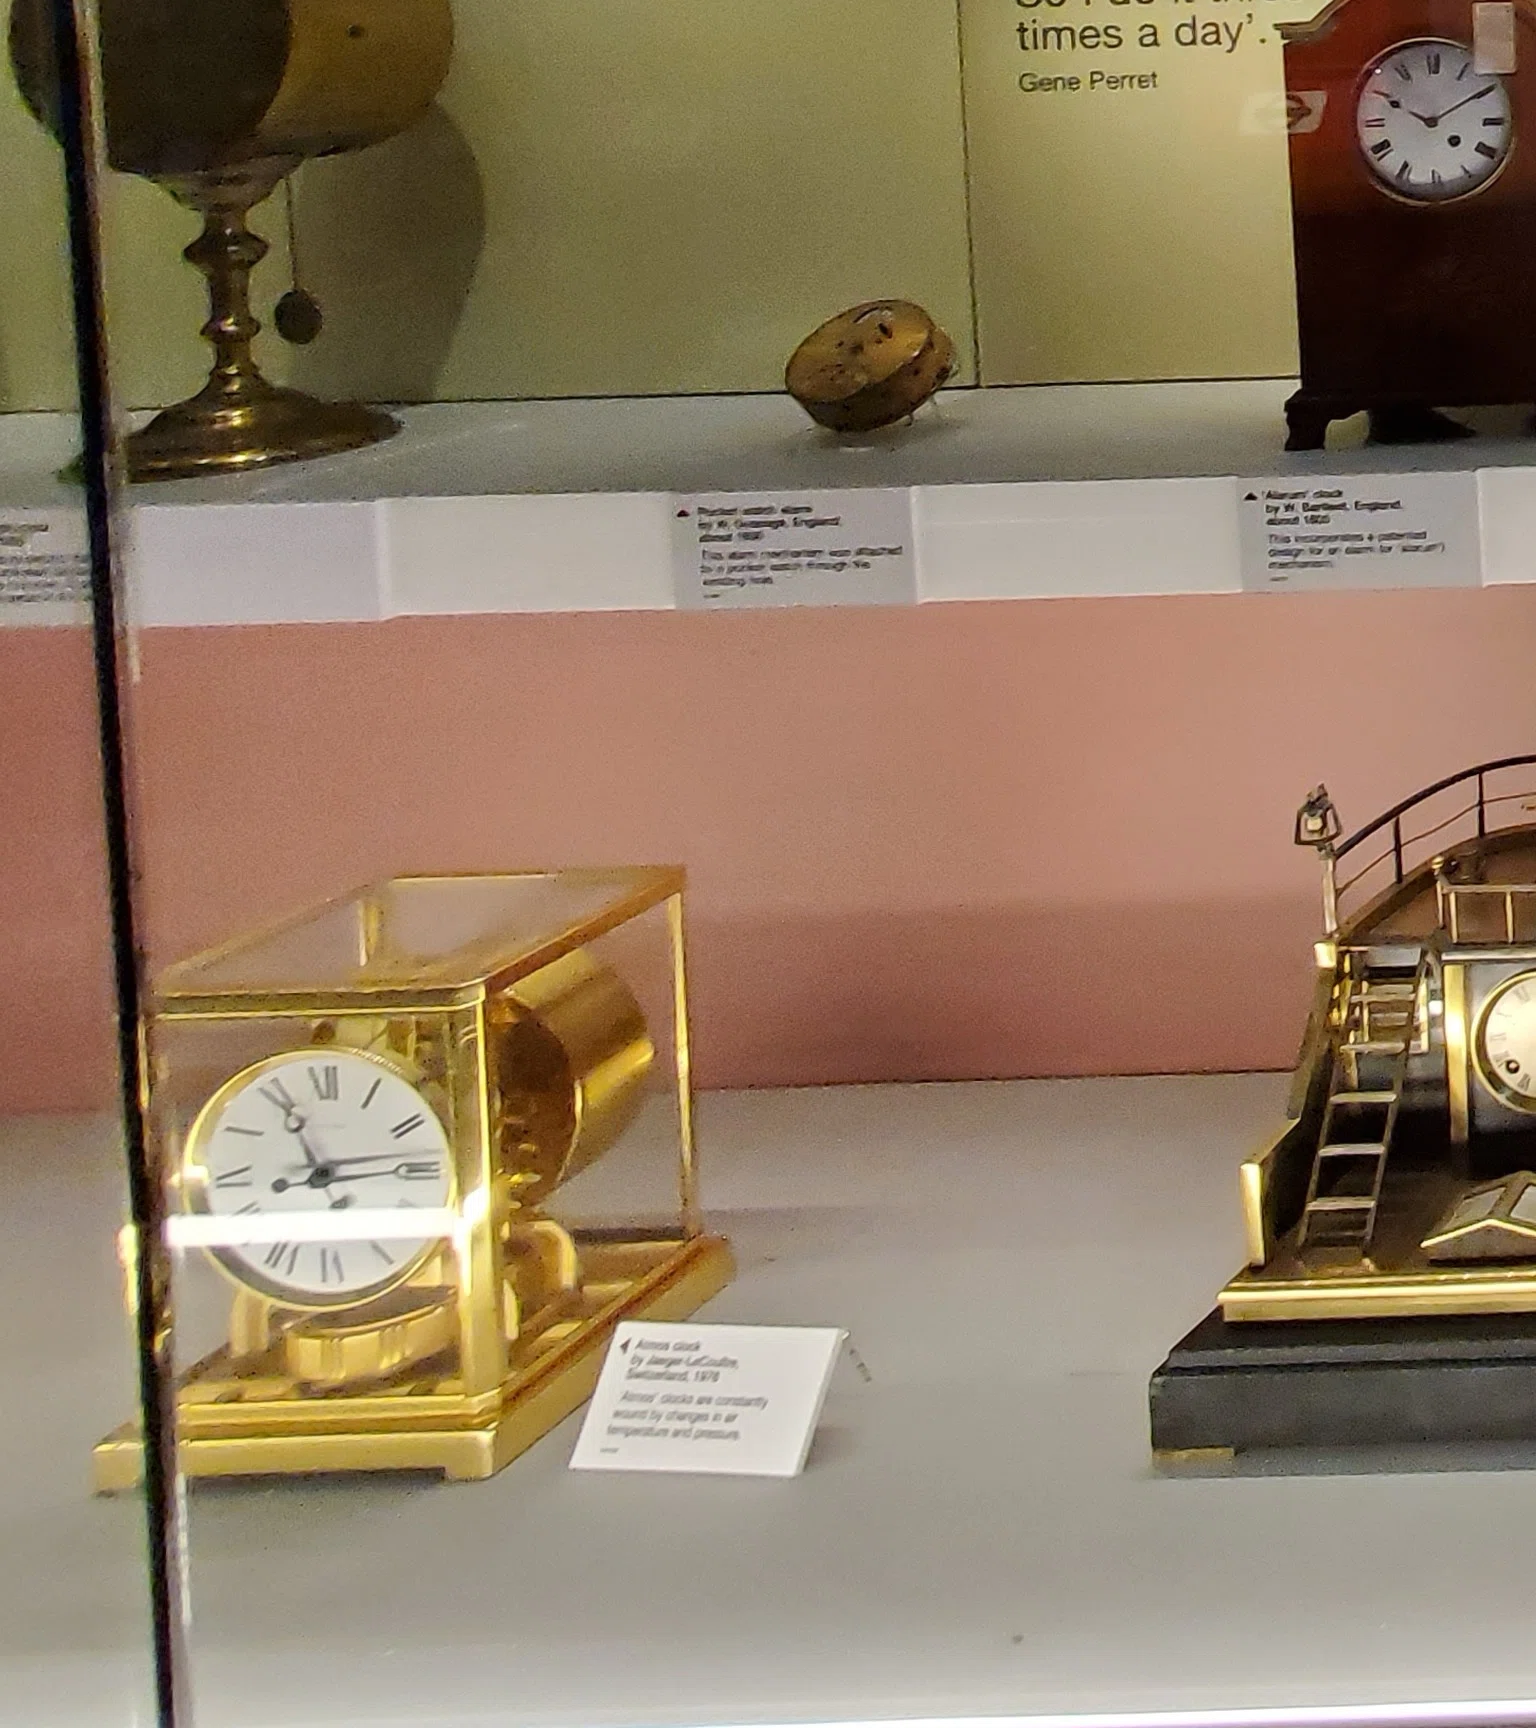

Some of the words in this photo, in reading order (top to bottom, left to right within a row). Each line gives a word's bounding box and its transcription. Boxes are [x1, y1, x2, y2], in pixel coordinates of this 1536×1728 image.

[1016, 19, 1123, 51] times
[1139, 24, 1160, 48] a
[1019, 72, 1081, 93] Gene
[1090, 71, 1158, 90] Perret
